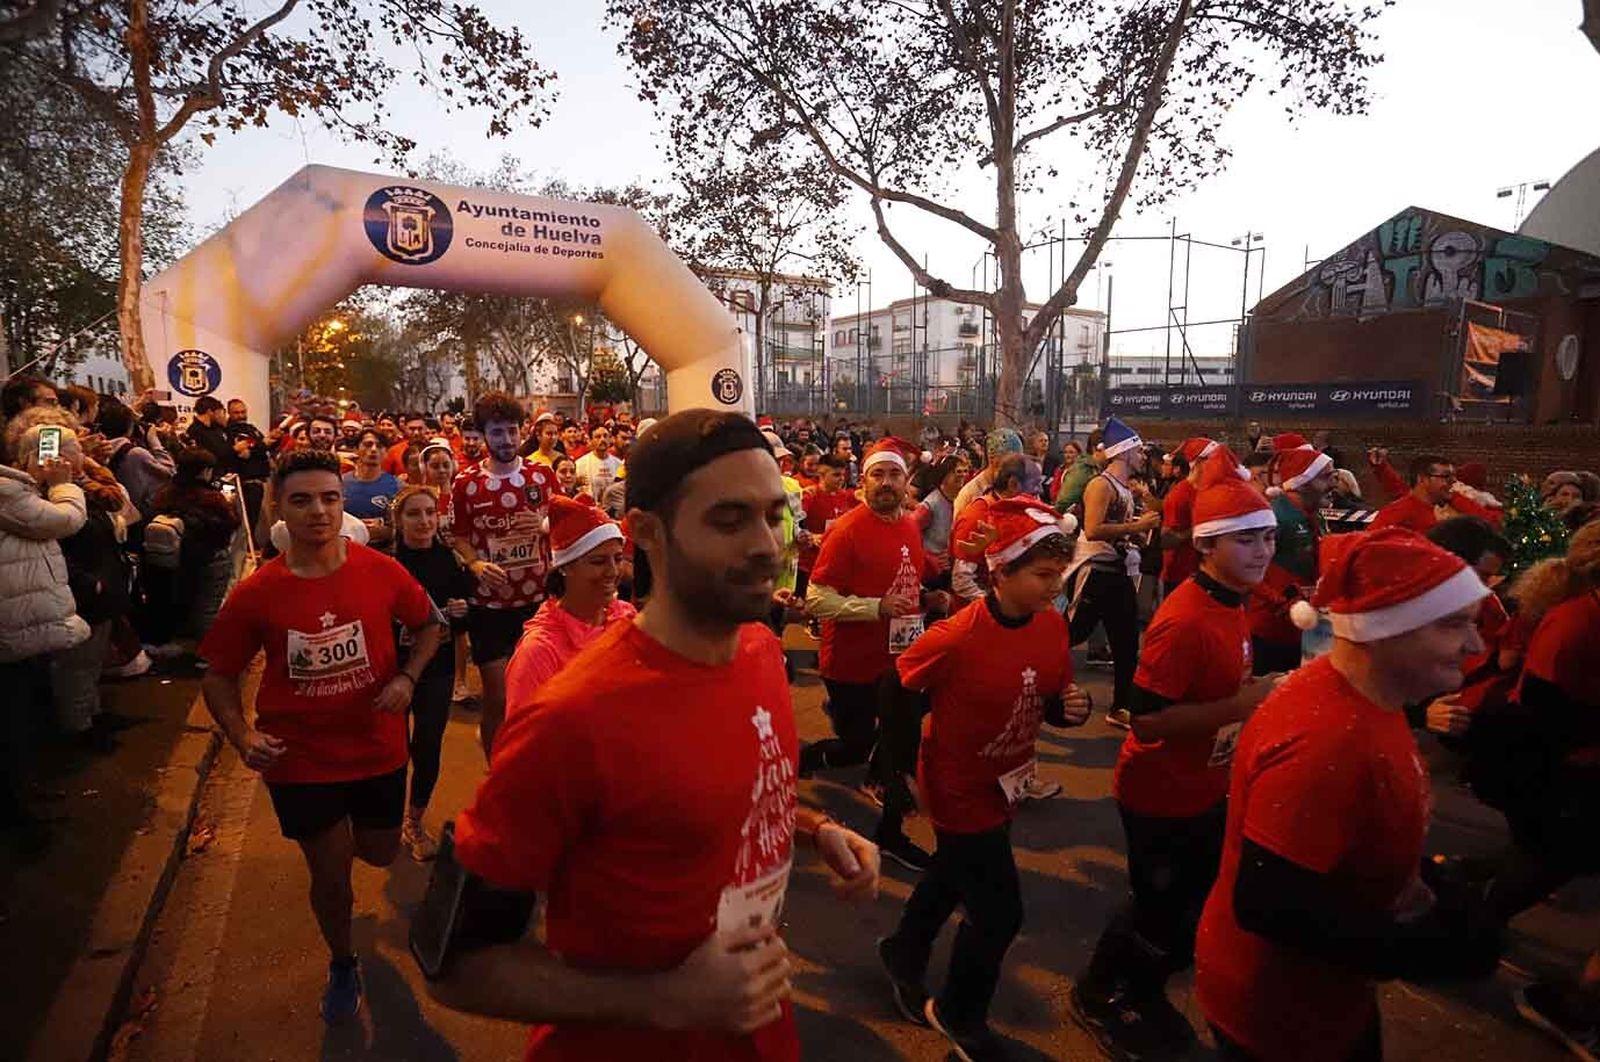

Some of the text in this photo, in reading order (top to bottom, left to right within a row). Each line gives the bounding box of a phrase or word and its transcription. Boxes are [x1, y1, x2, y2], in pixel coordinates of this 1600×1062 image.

[457, 199, 601, 228] Ayuntamiento
[501, 221, 602, 245] de Huelva
[534, 243, 549, 255] de
[552, 245, 604, 260] Deportes
[1186, 394, 1227, 404] HYUNDAI
[1268, 391, 1317, 401] HYUNDAI
[1352, 389, 1412, 400] HYUNDAI
[510, 544, 534, 560] 407
[318, 639, 358, 665] 300
